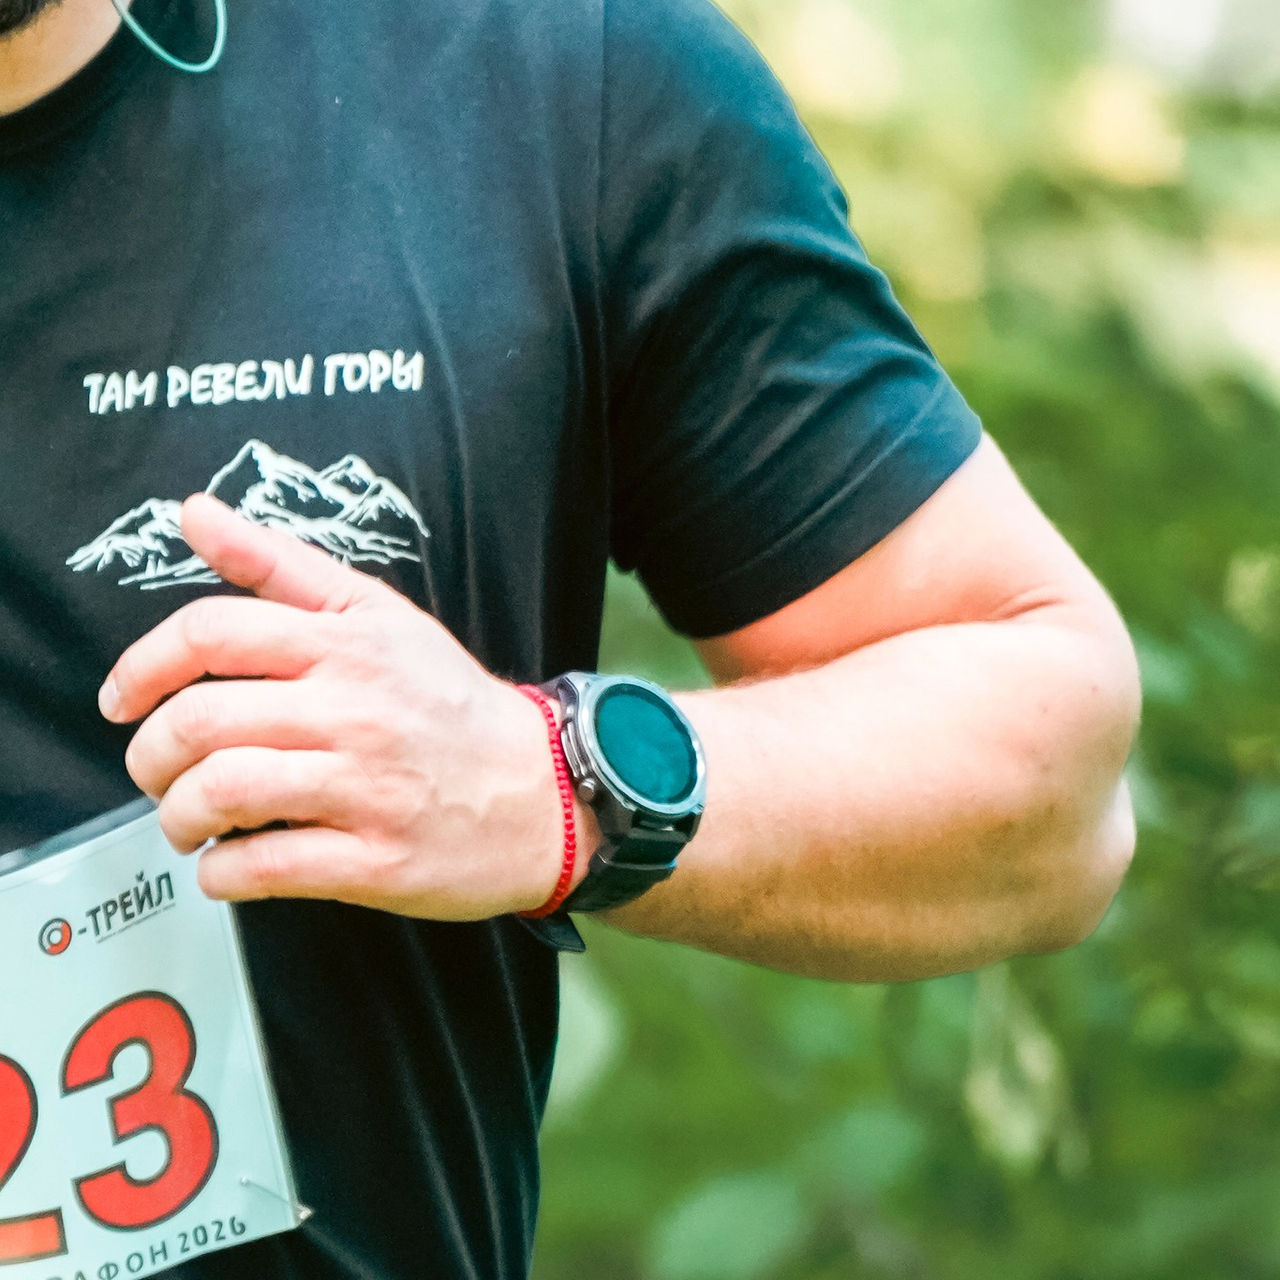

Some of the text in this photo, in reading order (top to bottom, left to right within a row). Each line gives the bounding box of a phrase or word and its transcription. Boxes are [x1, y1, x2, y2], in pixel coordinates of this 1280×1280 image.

[83, 348, 425, 415] ТАМ РЕВЕЛИ ГОРЫ
[177, 1215, 247, 1255] 2026
